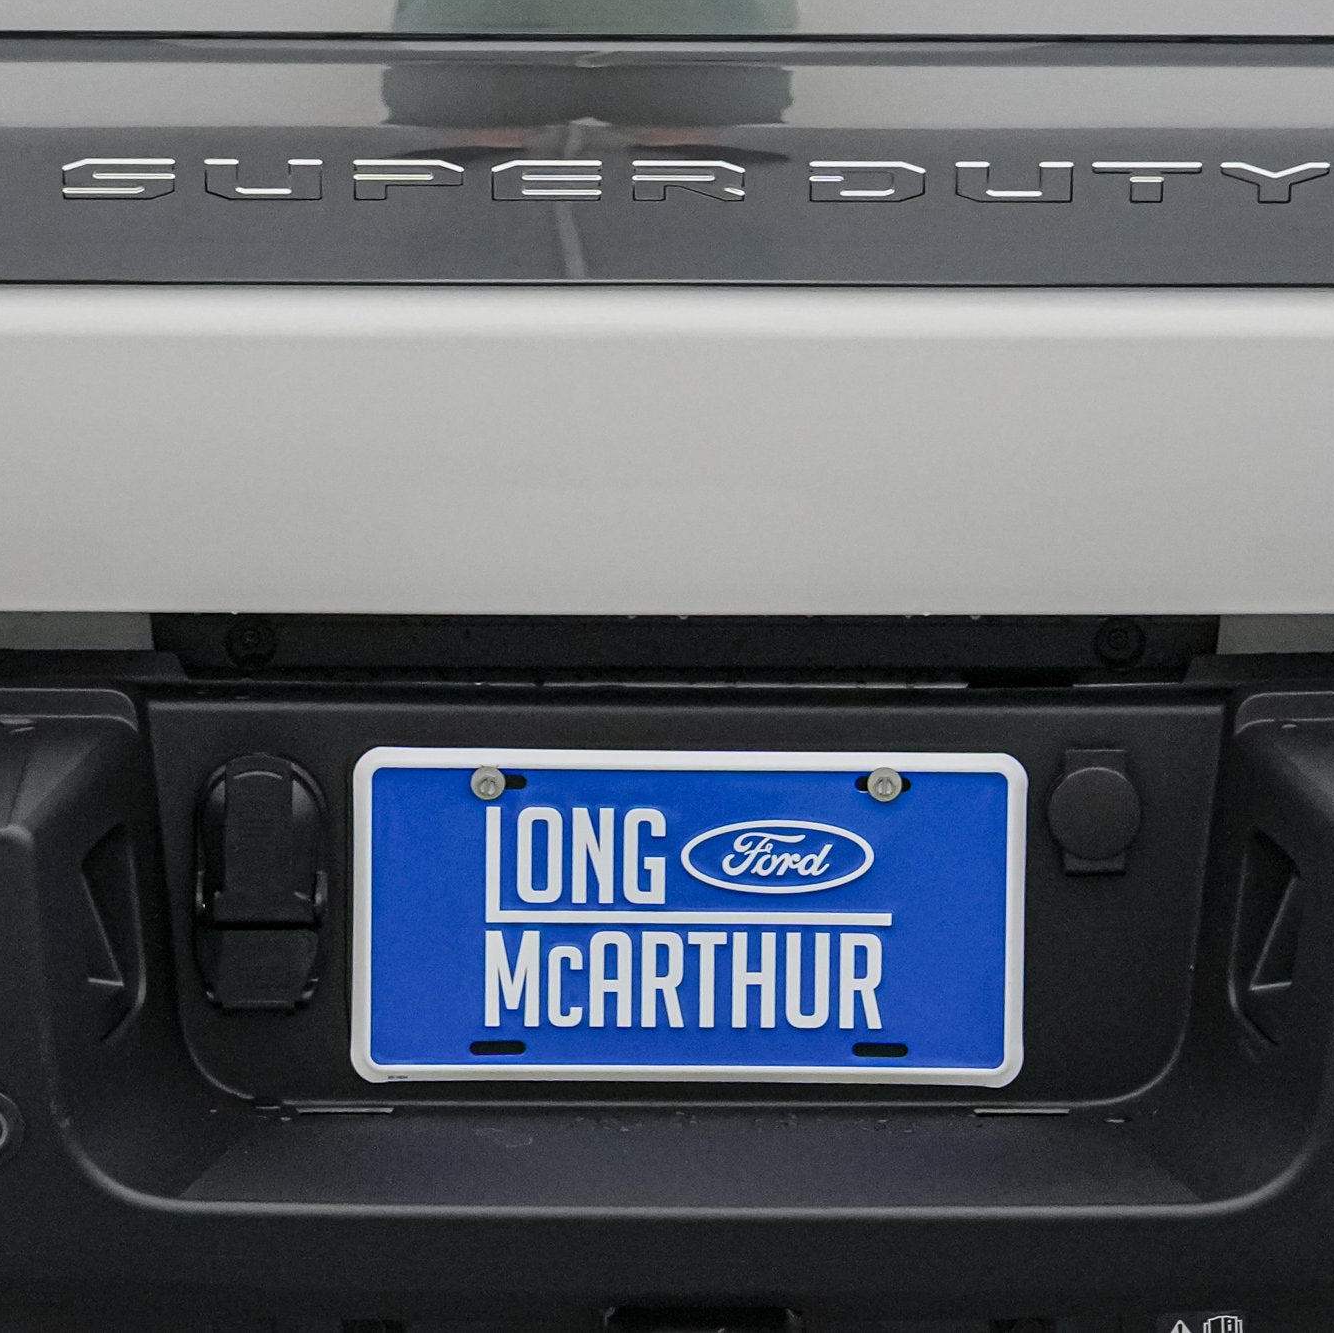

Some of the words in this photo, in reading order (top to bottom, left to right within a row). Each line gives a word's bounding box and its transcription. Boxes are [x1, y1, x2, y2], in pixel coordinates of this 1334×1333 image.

[62, 158, 747, 203] SUPER
[808, 159, 1332, 205] DUTY
[485, 806, 667, 923] LONG
[721, 831, 830, 877] Ford
[484, 930, 884, 1030] McARTHUR
